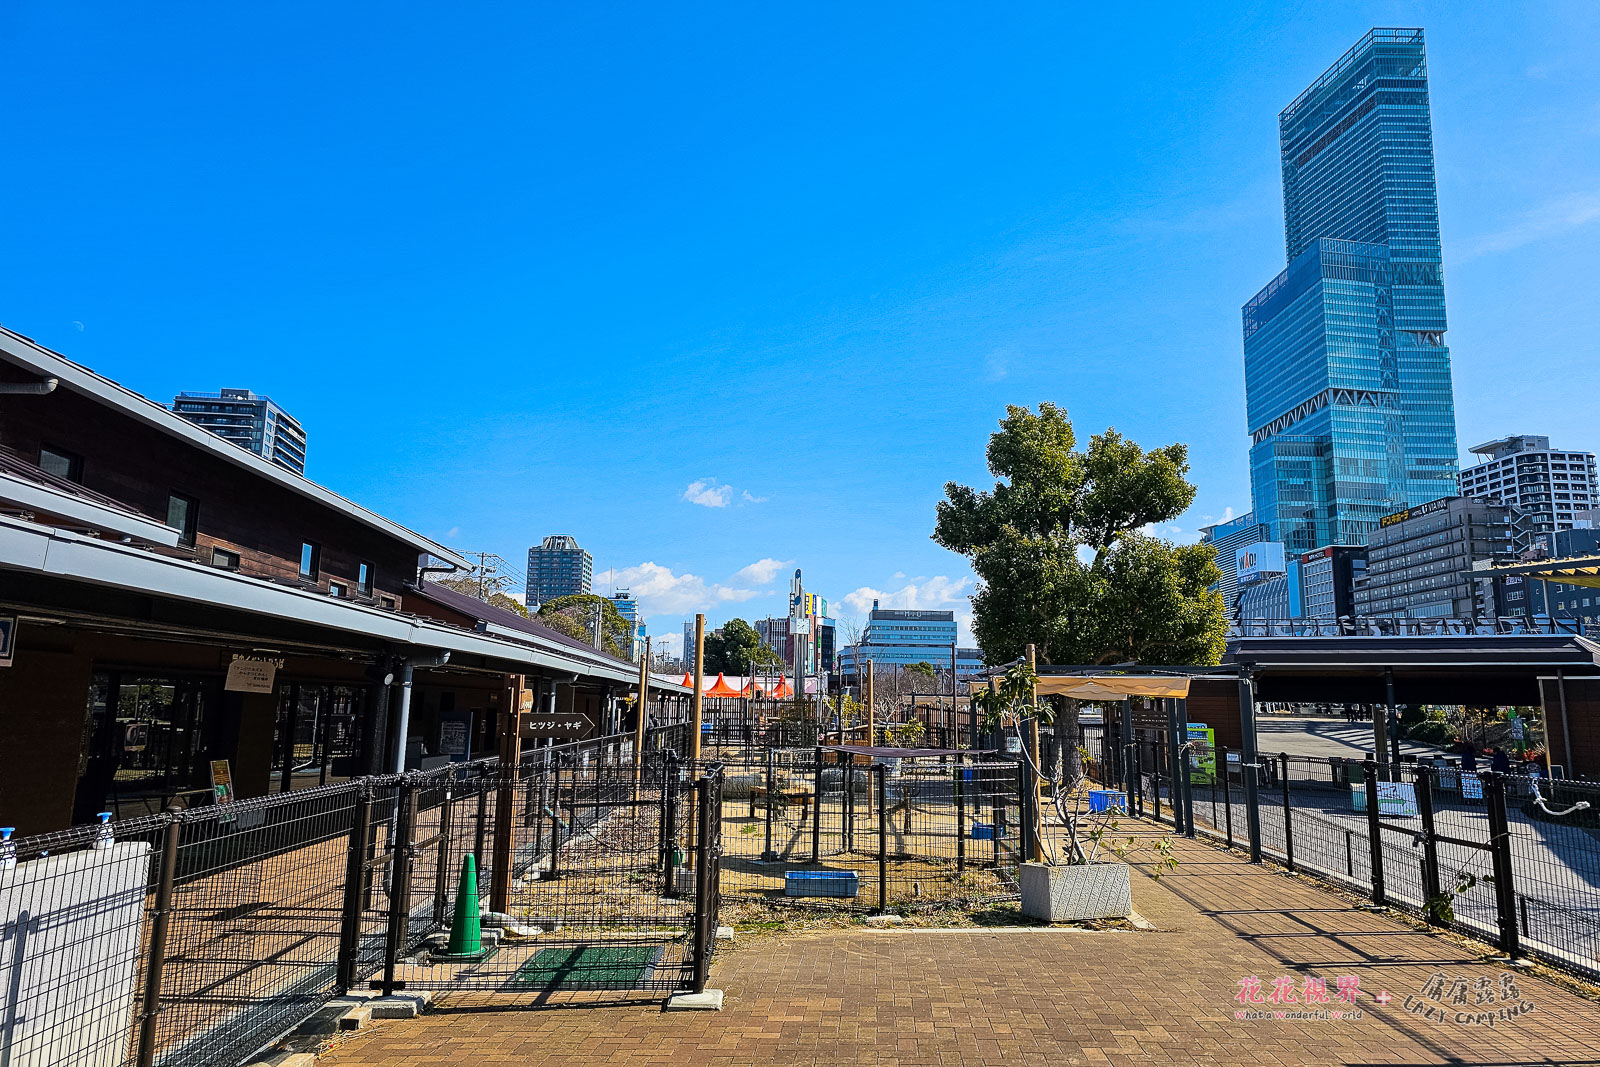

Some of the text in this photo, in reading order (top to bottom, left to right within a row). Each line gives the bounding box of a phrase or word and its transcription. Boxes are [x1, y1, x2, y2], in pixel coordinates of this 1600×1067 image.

[529, 721, 582, 730] ヒツジ・ヤギ
